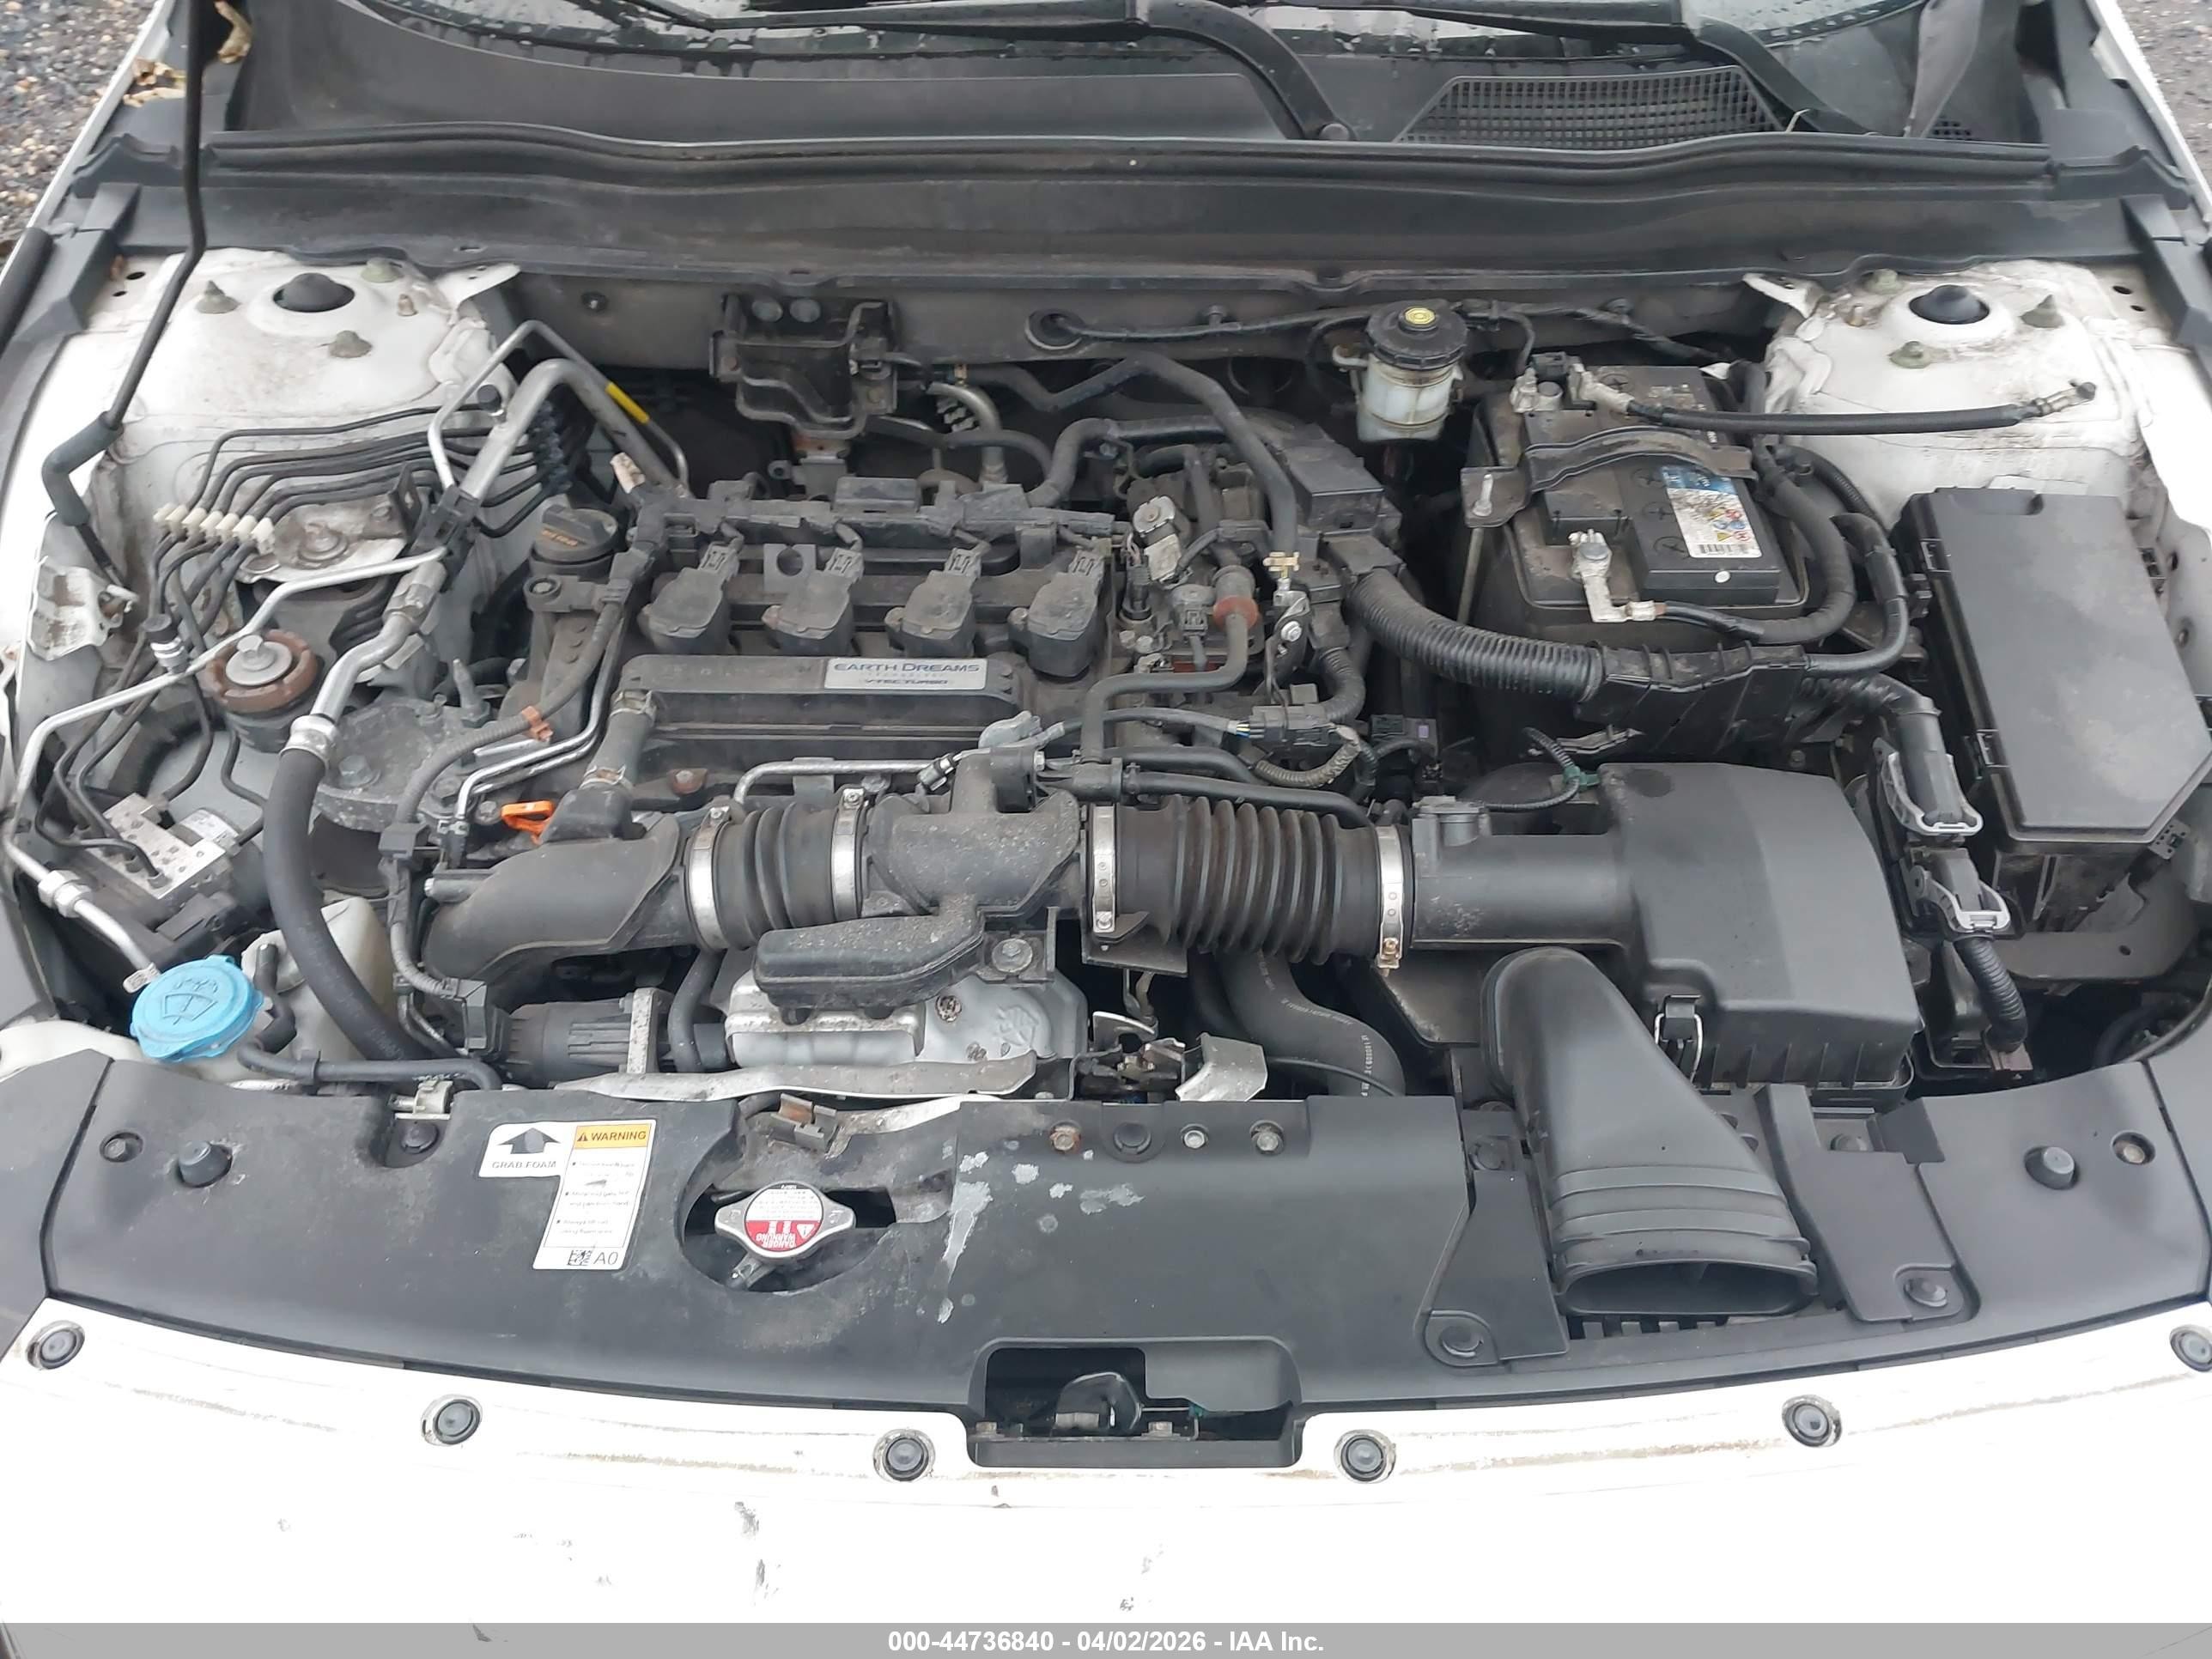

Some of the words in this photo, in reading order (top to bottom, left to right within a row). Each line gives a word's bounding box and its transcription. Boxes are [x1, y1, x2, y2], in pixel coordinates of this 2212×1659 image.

[834, 663, 898, 672] EARTH
[901, 662, 981, 673] DREAMS
[591, 1131, 647, 1142] WARNING
[491, 1160, 523, 1170] GRAB
[525, 1159, 556, 1170] FOAM
